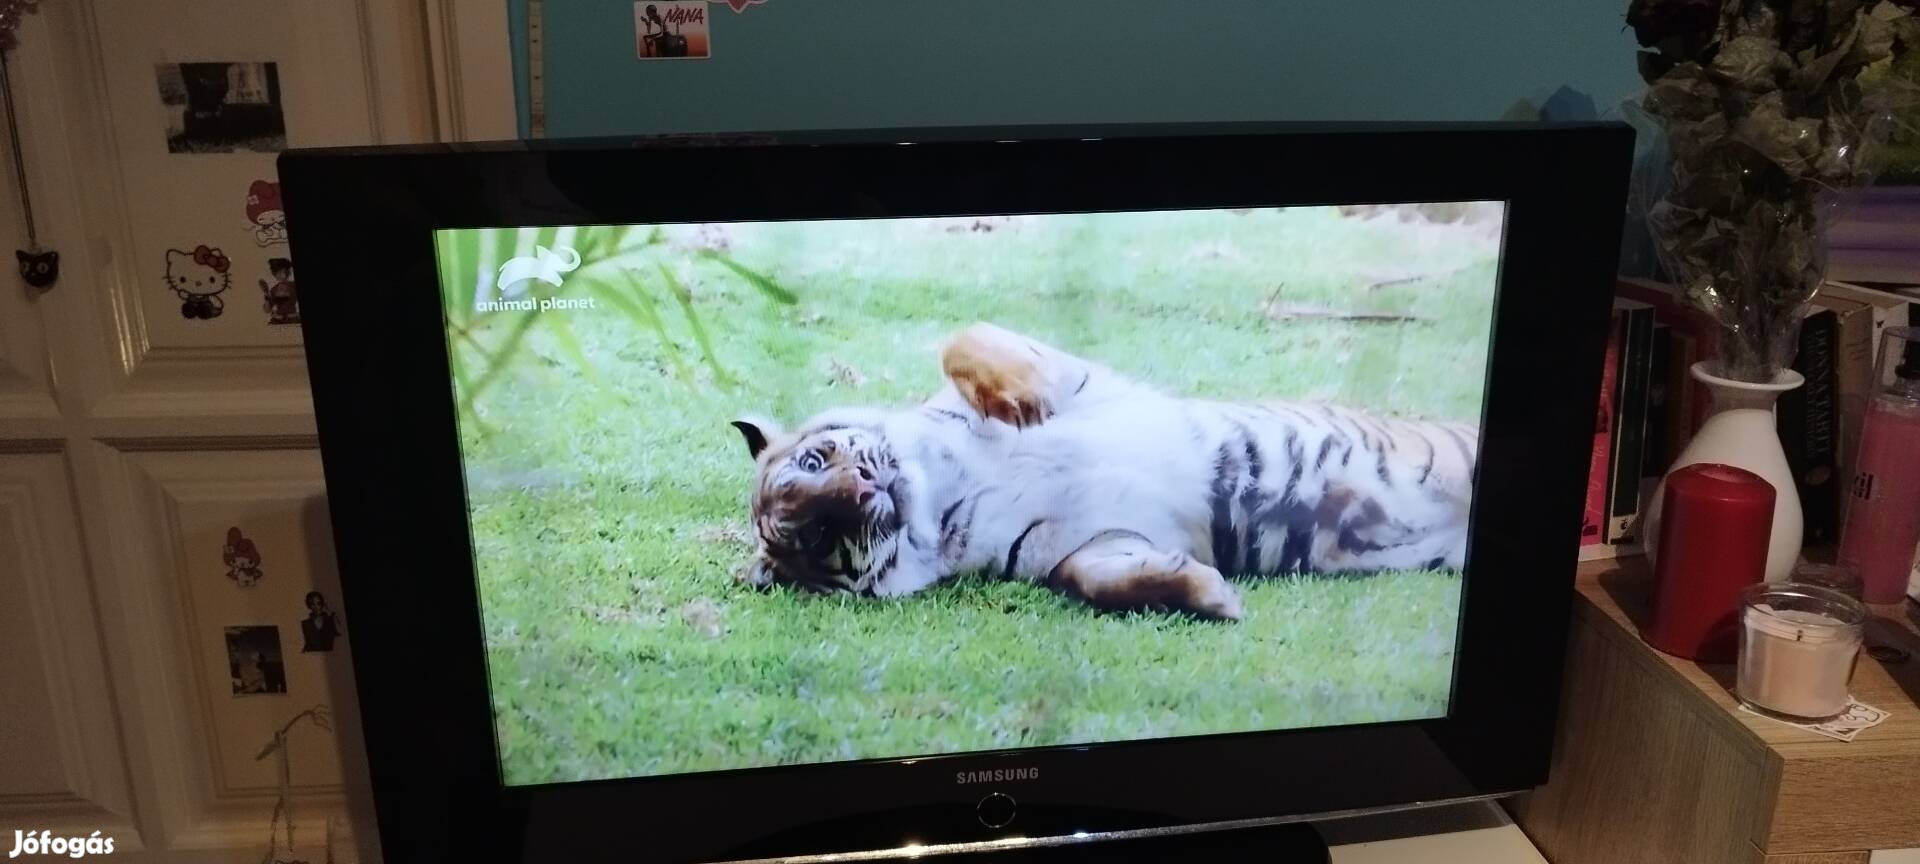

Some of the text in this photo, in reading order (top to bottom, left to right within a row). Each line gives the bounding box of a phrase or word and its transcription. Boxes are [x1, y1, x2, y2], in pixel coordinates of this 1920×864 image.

[664, 6, 704, 25] NANA
[476, 296, 596, 312] animal planet
[956, 767, 1040, 784] SAMSUNG
